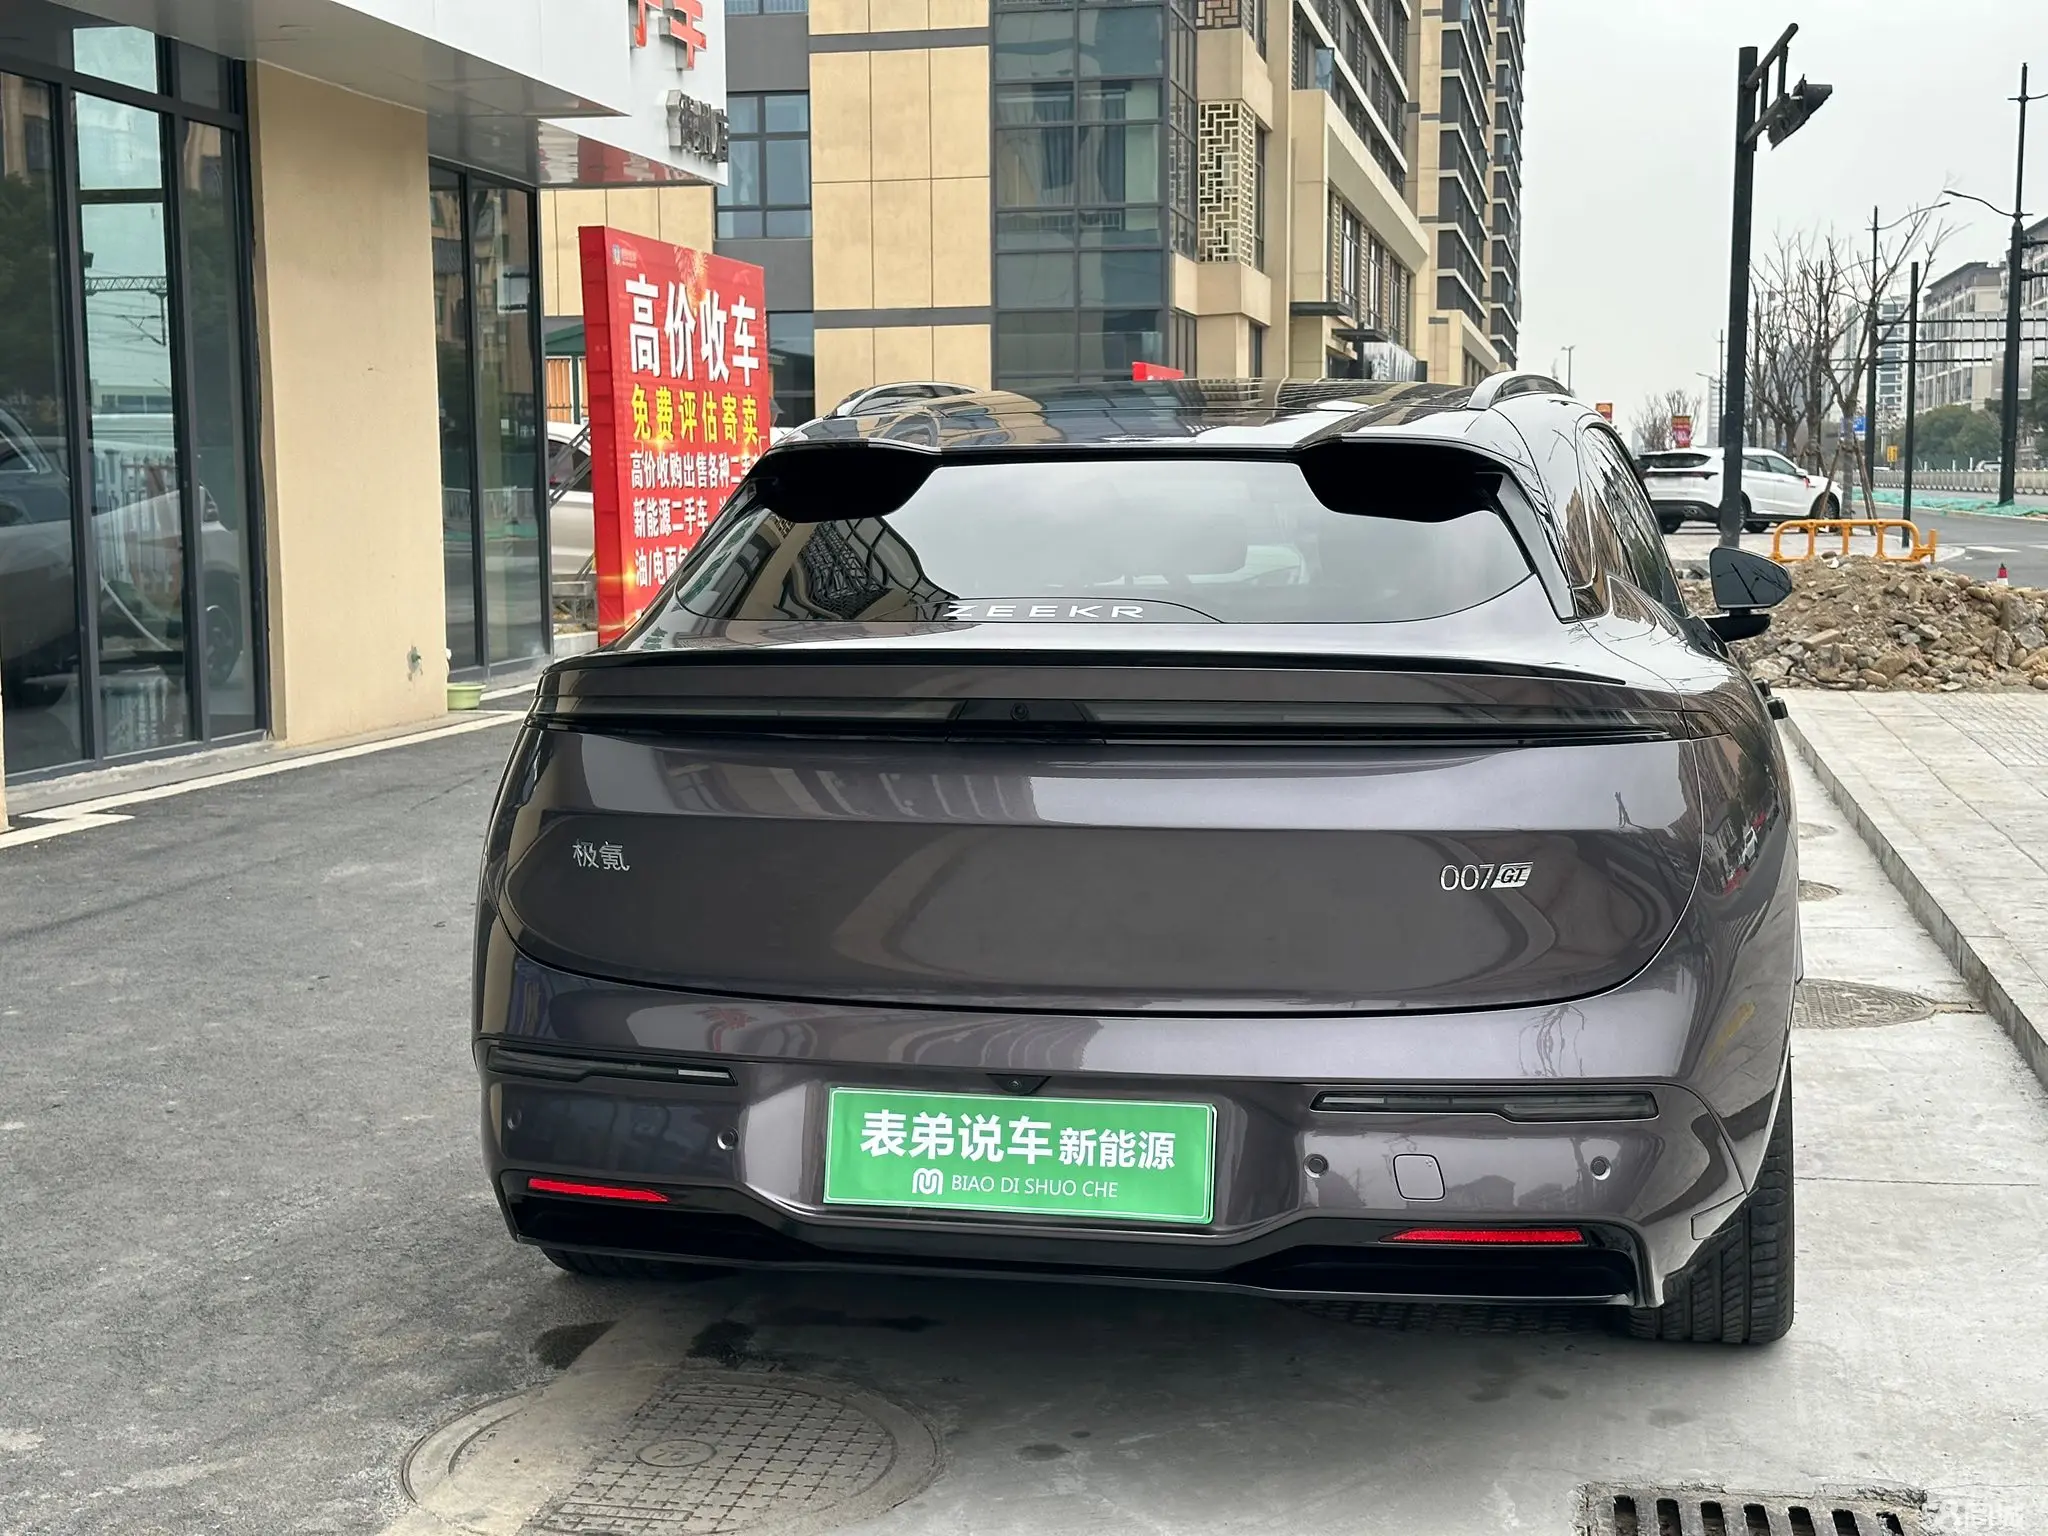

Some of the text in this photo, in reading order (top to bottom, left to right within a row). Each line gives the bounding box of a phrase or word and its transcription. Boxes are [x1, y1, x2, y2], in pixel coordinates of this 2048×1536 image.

[625, 272, 760, 388] 高价收车
[630, 382, 759, 447] 免费评估寄卖
[630, 451, 758, 489] 高价收购出售各种二手
[632, 496, 709, 539] 新能源二手车
[943, 605, 1144, 618] ZEEKR
[572, 839, 630, 871] 极氪
[859, 1109, 1176, 1170] 表弟说车 新能源
[952, 1174, 1119, 1198] BIAO DI SHUO CHE
